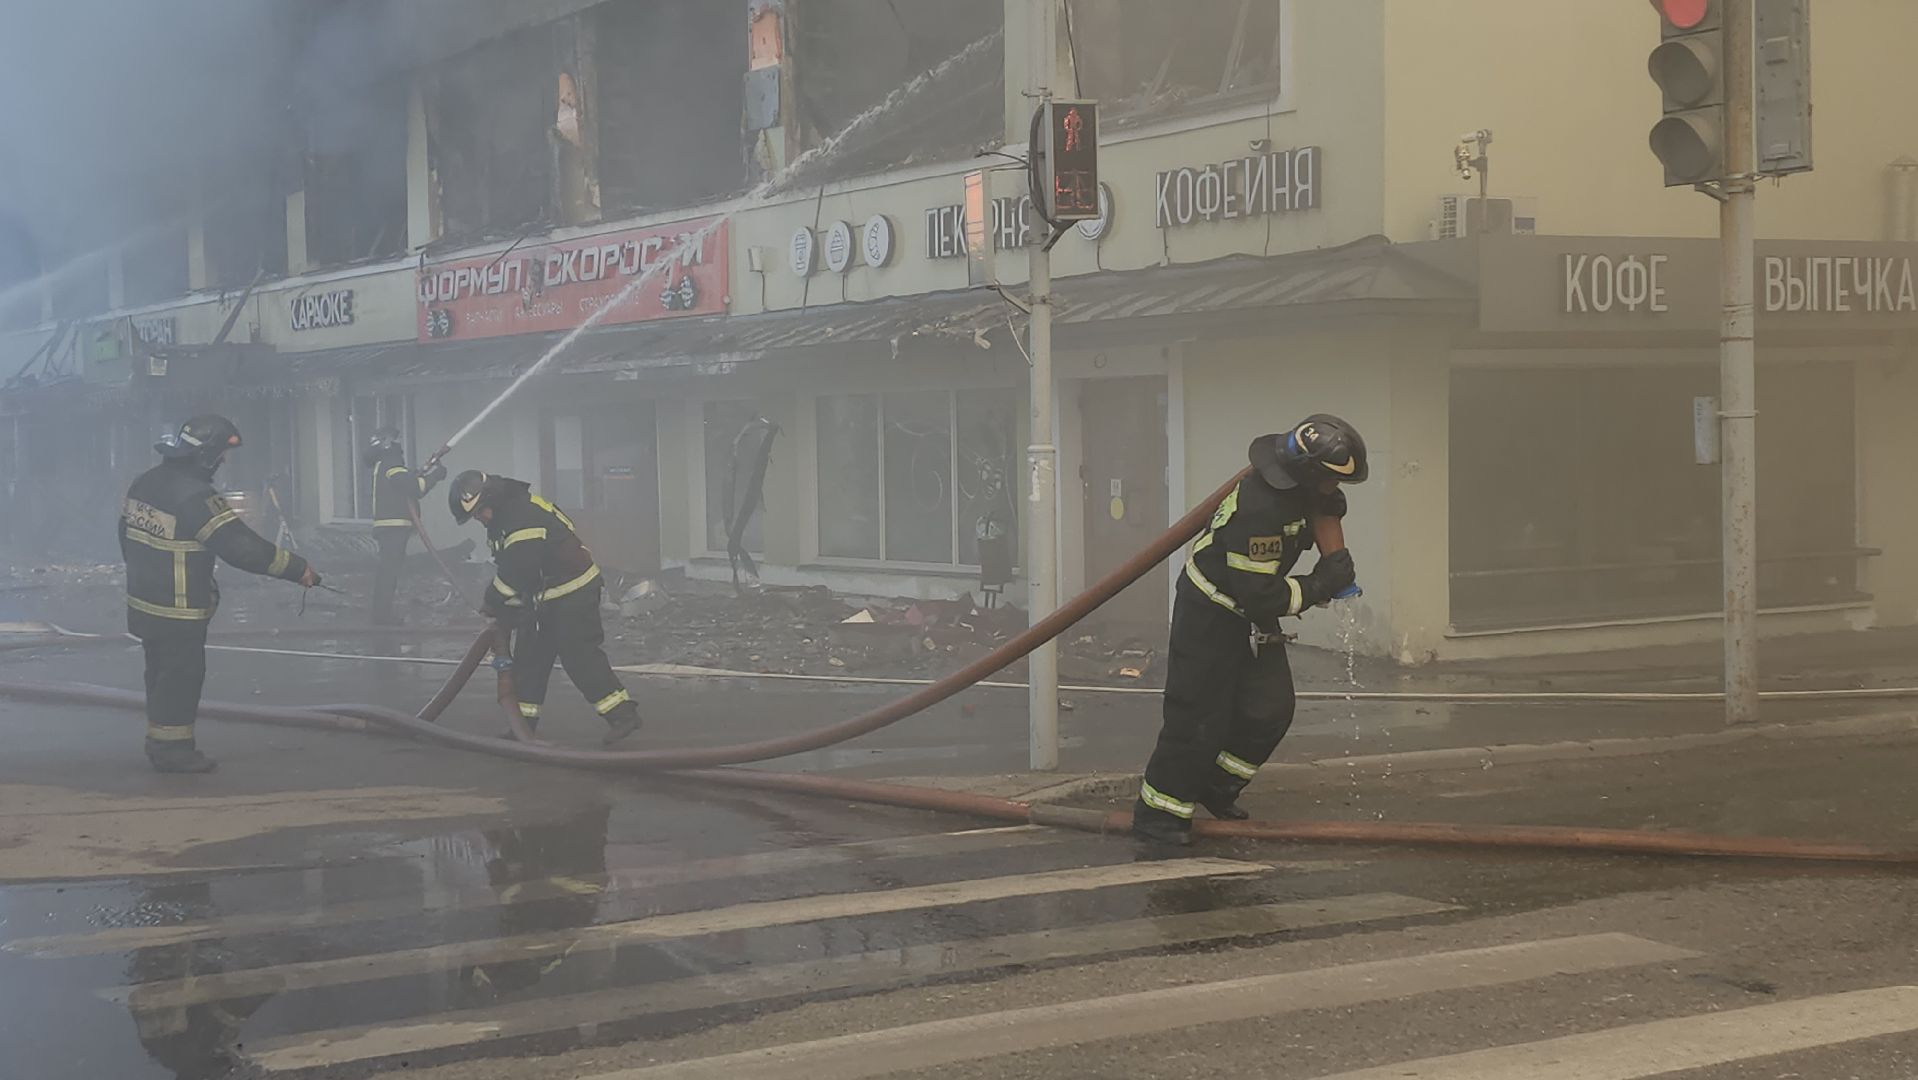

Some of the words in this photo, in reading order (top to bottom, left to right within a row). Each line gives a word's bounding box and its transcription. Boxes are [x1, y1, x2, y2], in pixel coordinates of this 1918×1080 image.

[1156, 139, 1315, 228] КОФЕЙНЯ
[416, 256, 530, 306] ФОРМУЛ
[1565, 254, 1668, 313] КОФЕ
[1764, 256, 1918, 312] ВЫПЕЧКА
[291, 290, 351, 329] КАРАОКЕ
